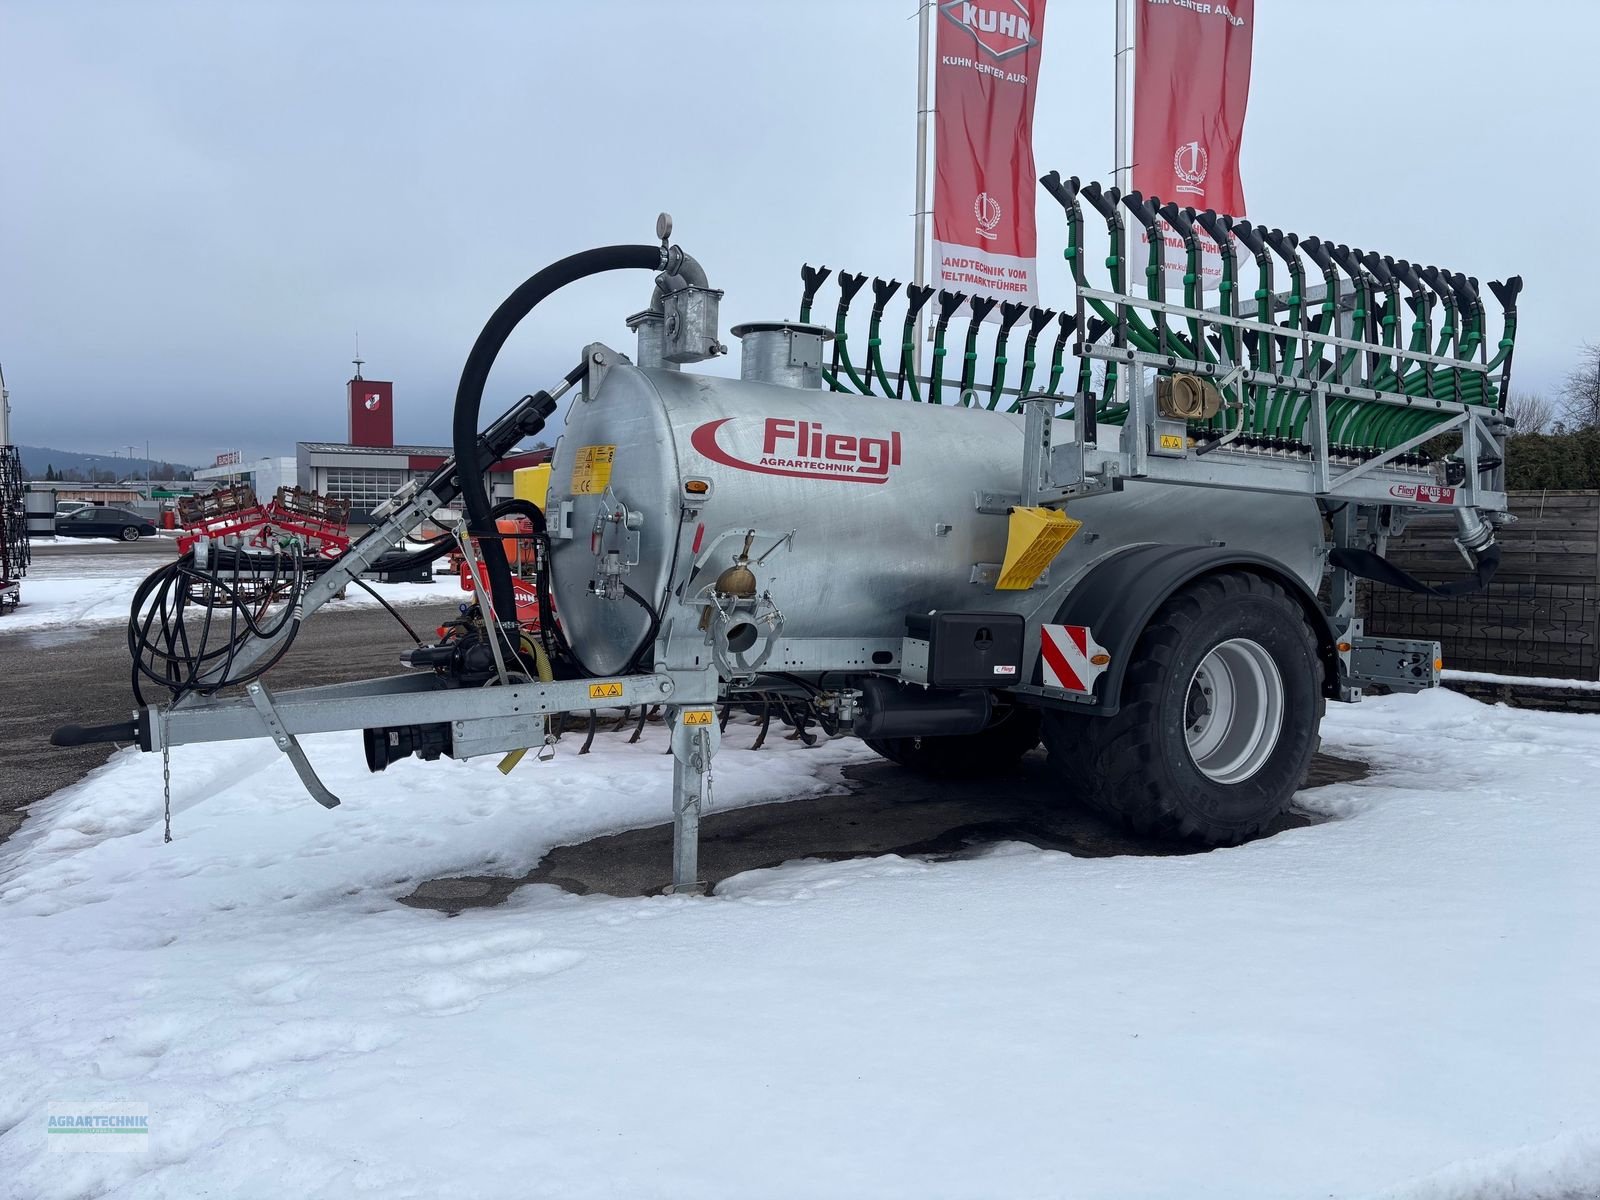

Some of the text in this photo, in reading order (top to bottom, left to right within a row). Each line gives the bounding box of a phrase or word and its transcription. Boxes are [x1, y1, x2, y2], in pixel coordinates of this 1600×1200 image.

[963, 1, 1030, 42] KUHN
[942, 55, 972, 68] KUHN
[974, 61, 1004, 79] CENTER
[942, 256, 1027, 279] LANDTECHNIK VOM
[763, 417, 902, 475] Fliegl
[759, 457, 855, 473] AGRARTECHNIK
[1420, 486, 1441, 497] SKATE
[1442, 488, 1451, 497] 90
[515, 593, 535, 602] UHN
